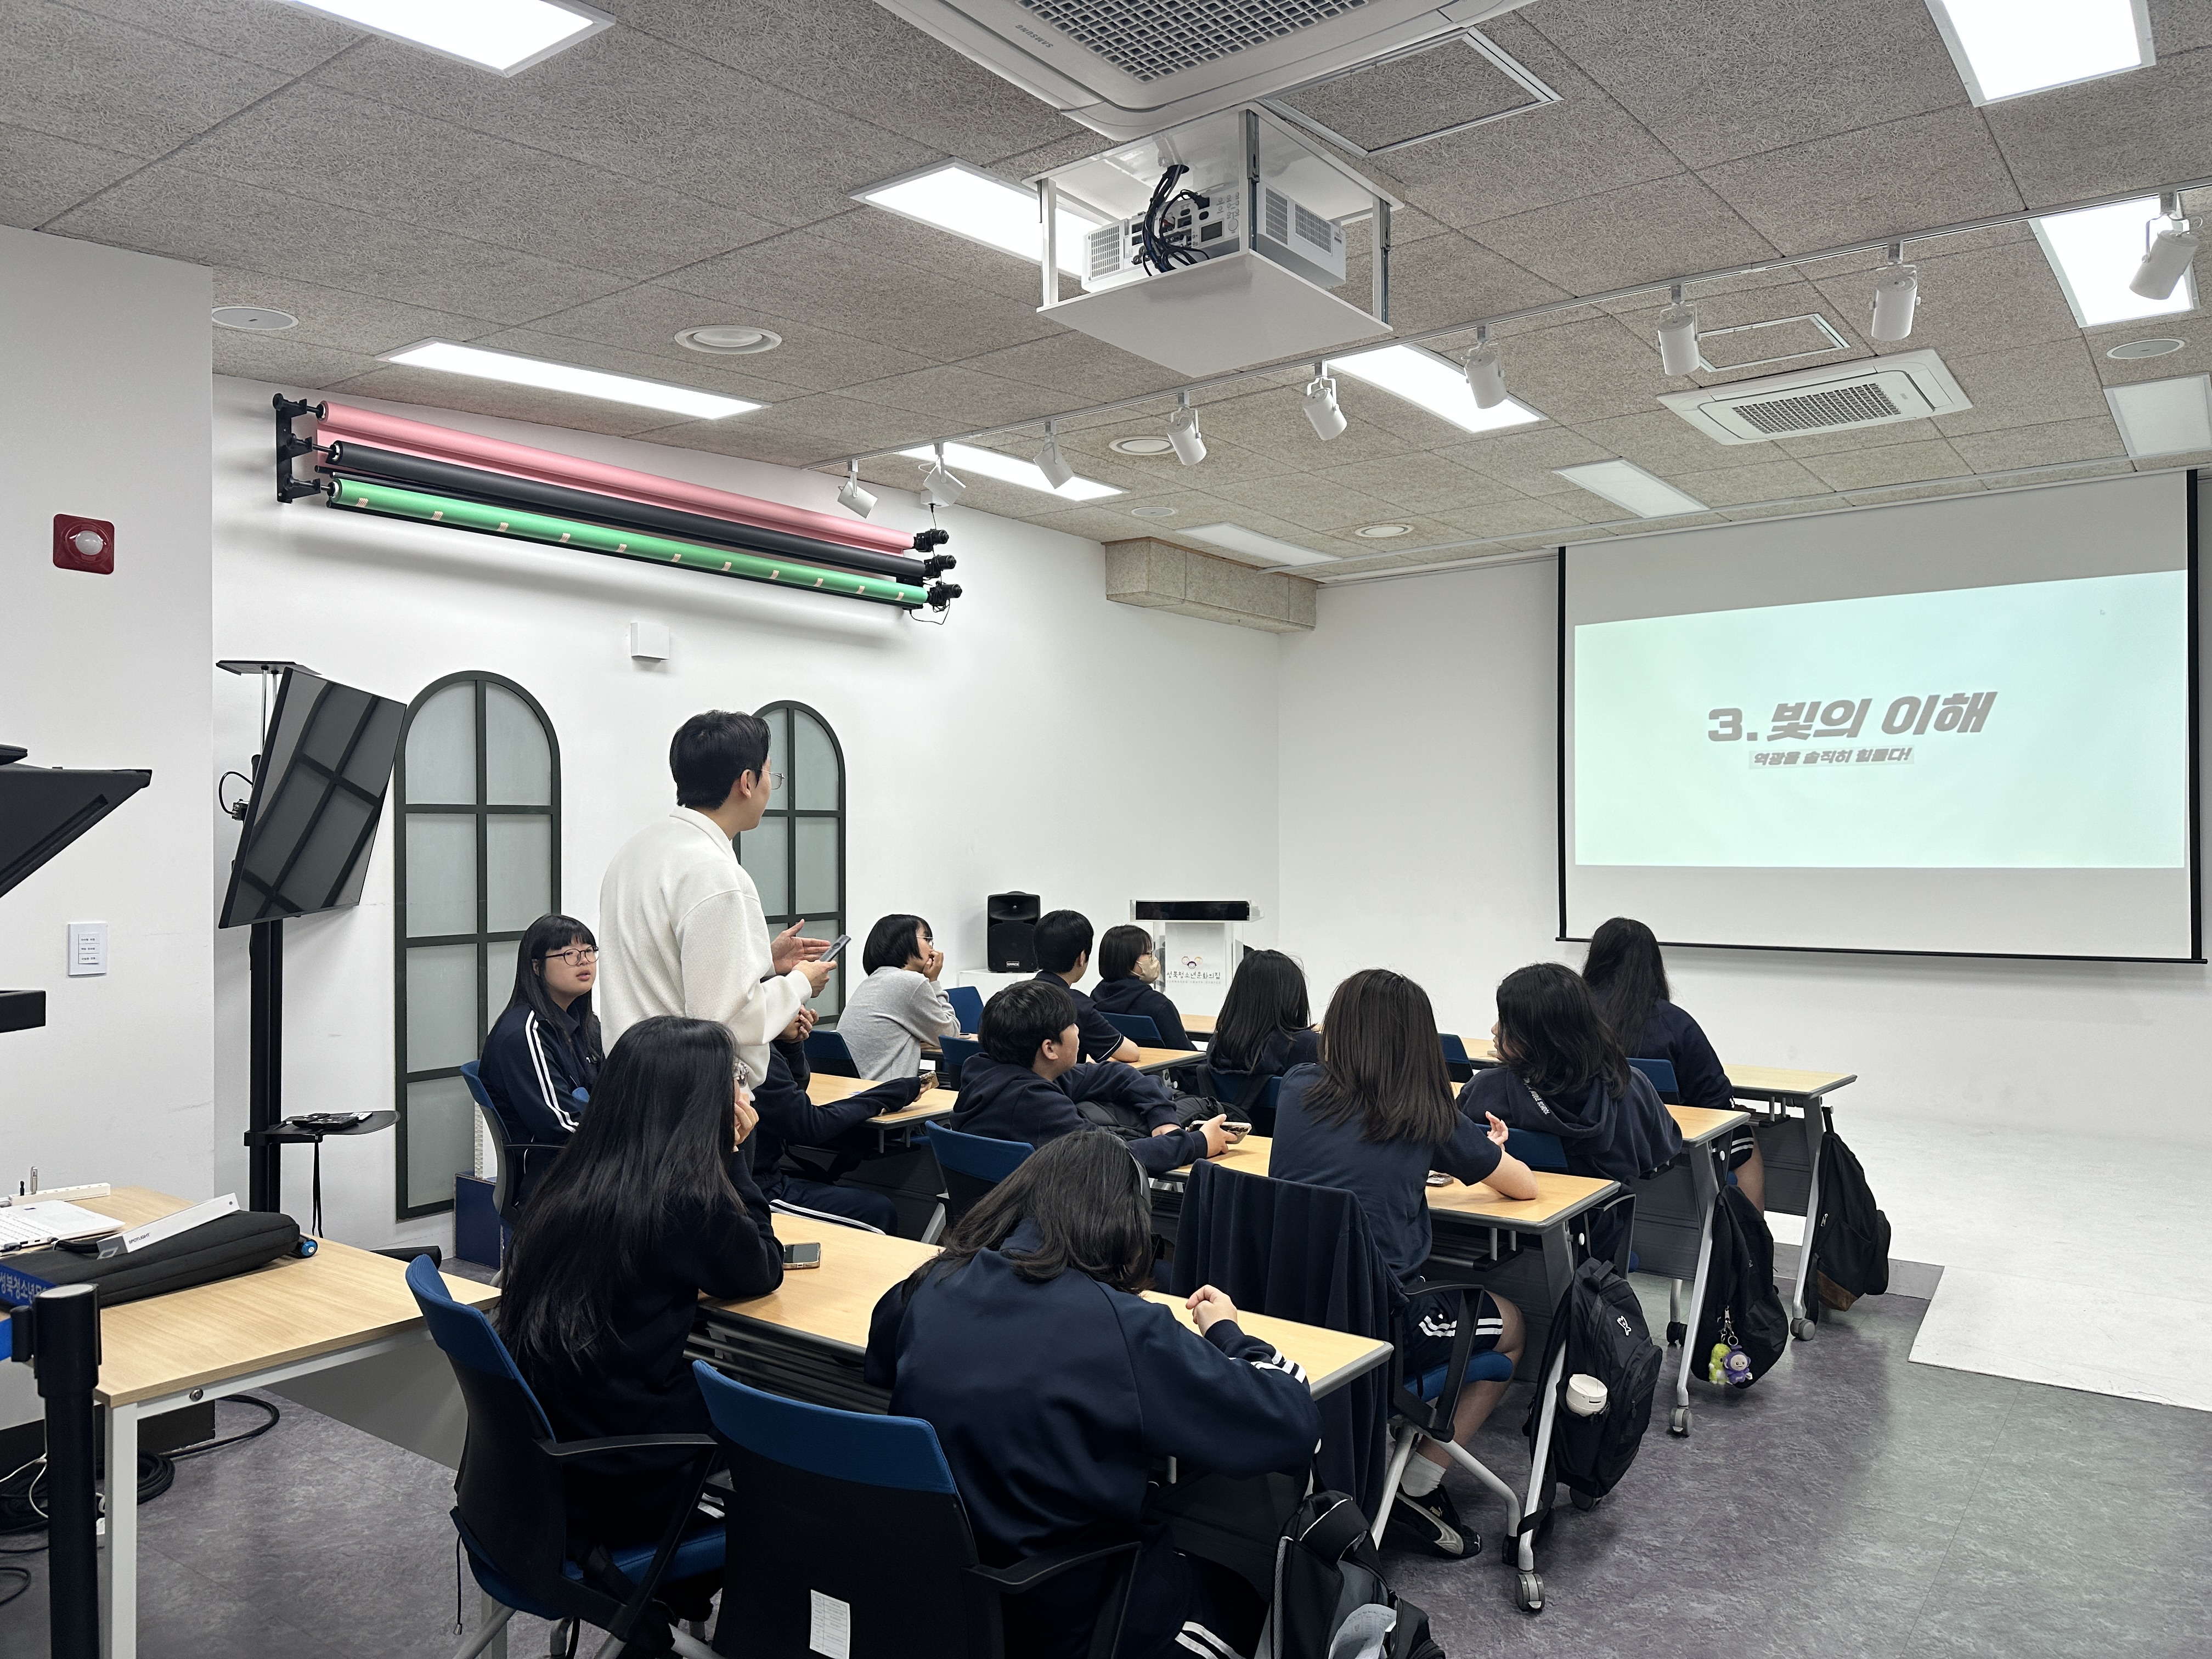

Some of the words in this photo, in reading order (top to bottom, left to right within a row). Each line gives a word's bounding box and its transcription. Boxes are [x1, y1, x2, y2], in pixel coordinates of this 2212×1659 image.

[1014, 24, 1054, 48] SAMSUNG
[1708, 708, 1758, 742] 3.
[1767, 698, 1873, 742] 빛의
[1881, 691, 1998, 735] 이해
[1803, 749, 1854, 764] 솔직히
[1855, 747, 1913, 763] 힘들다!
[1166, 970, 1221, 980] 성북청소년문화의집
[1537, 1101, 1551, 1115] SCHOOL
[128, 1233, 150, 1244] SPOTLIGHT
[0, 1272, 46, 1304] 성북청소년
